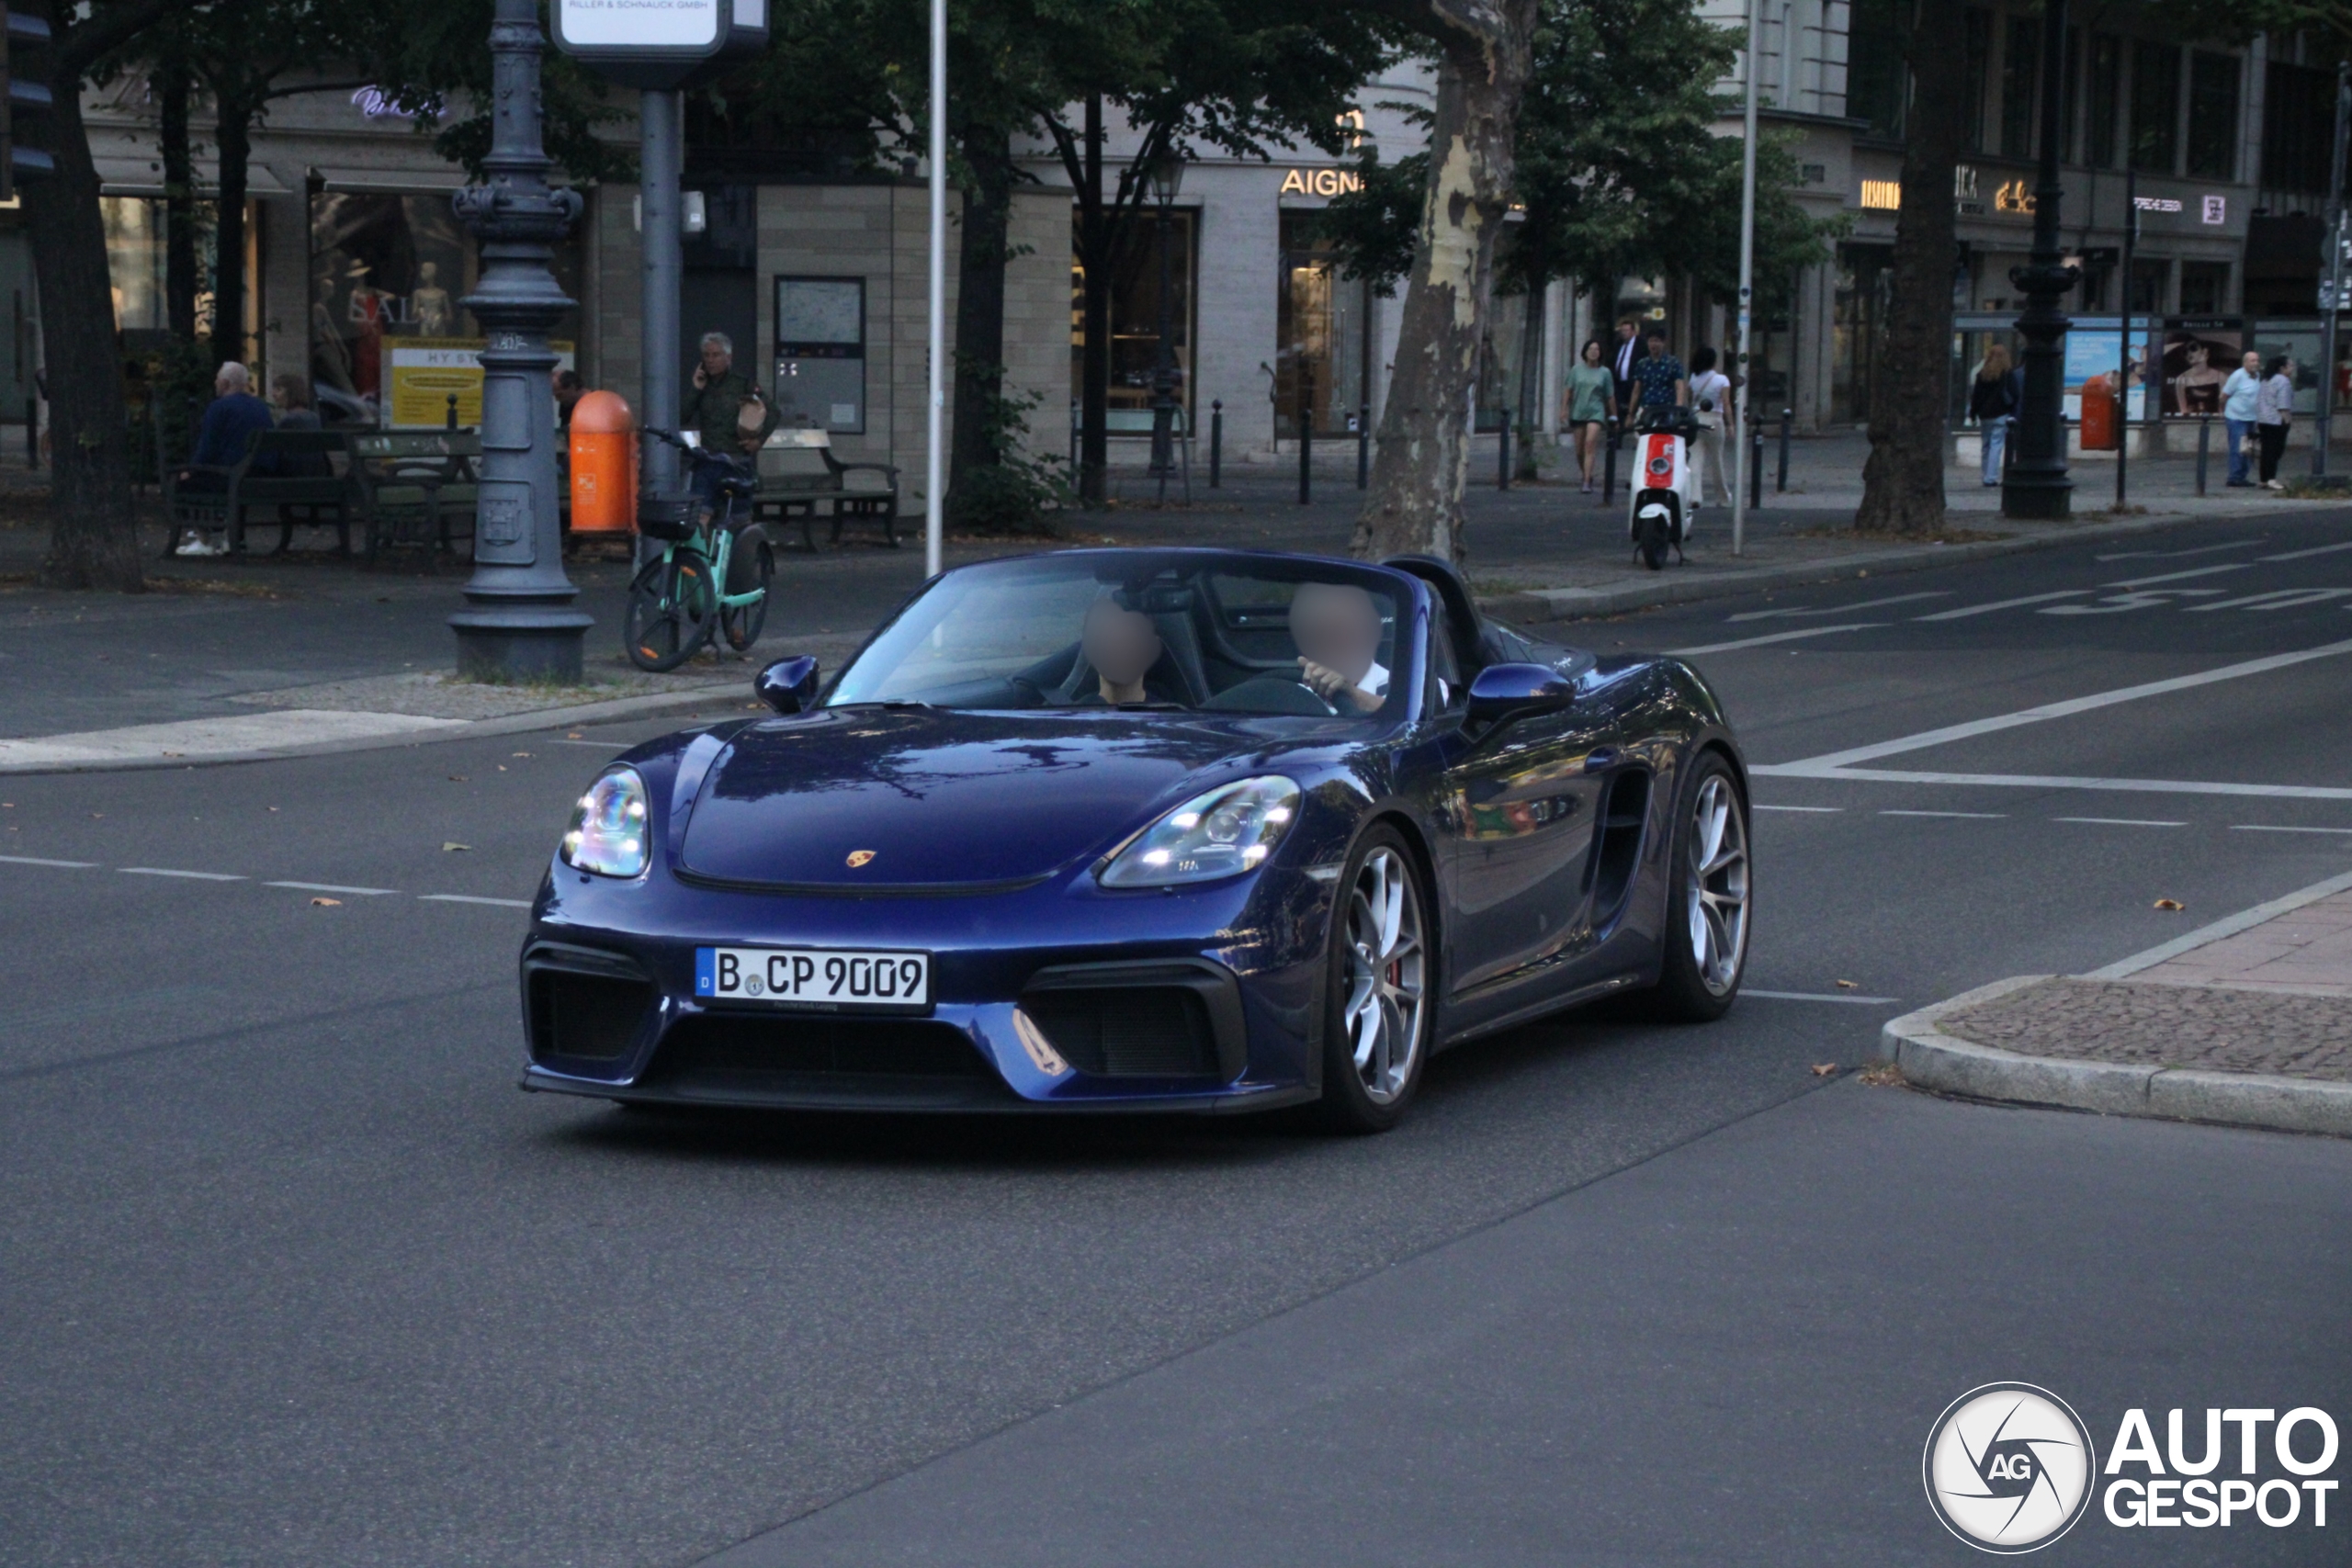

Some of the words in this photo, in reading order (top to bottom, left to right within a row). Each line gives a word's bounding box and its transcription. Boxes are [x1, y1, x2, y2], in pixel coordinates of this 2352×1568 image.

[570, 0, 604, 8] RILLER
[607, 0, 614, 8] &
[617, 0, 673, 9] SCHNAUCK
[677, 0, 707, 9] GMBH
[349, 296, 421, 323] SAL
[701, 977, 709, 987] D
[718, 953, 741, 992] B
[767, 955, 814, 994] CP
[825, 957, 922, 998] 9009
